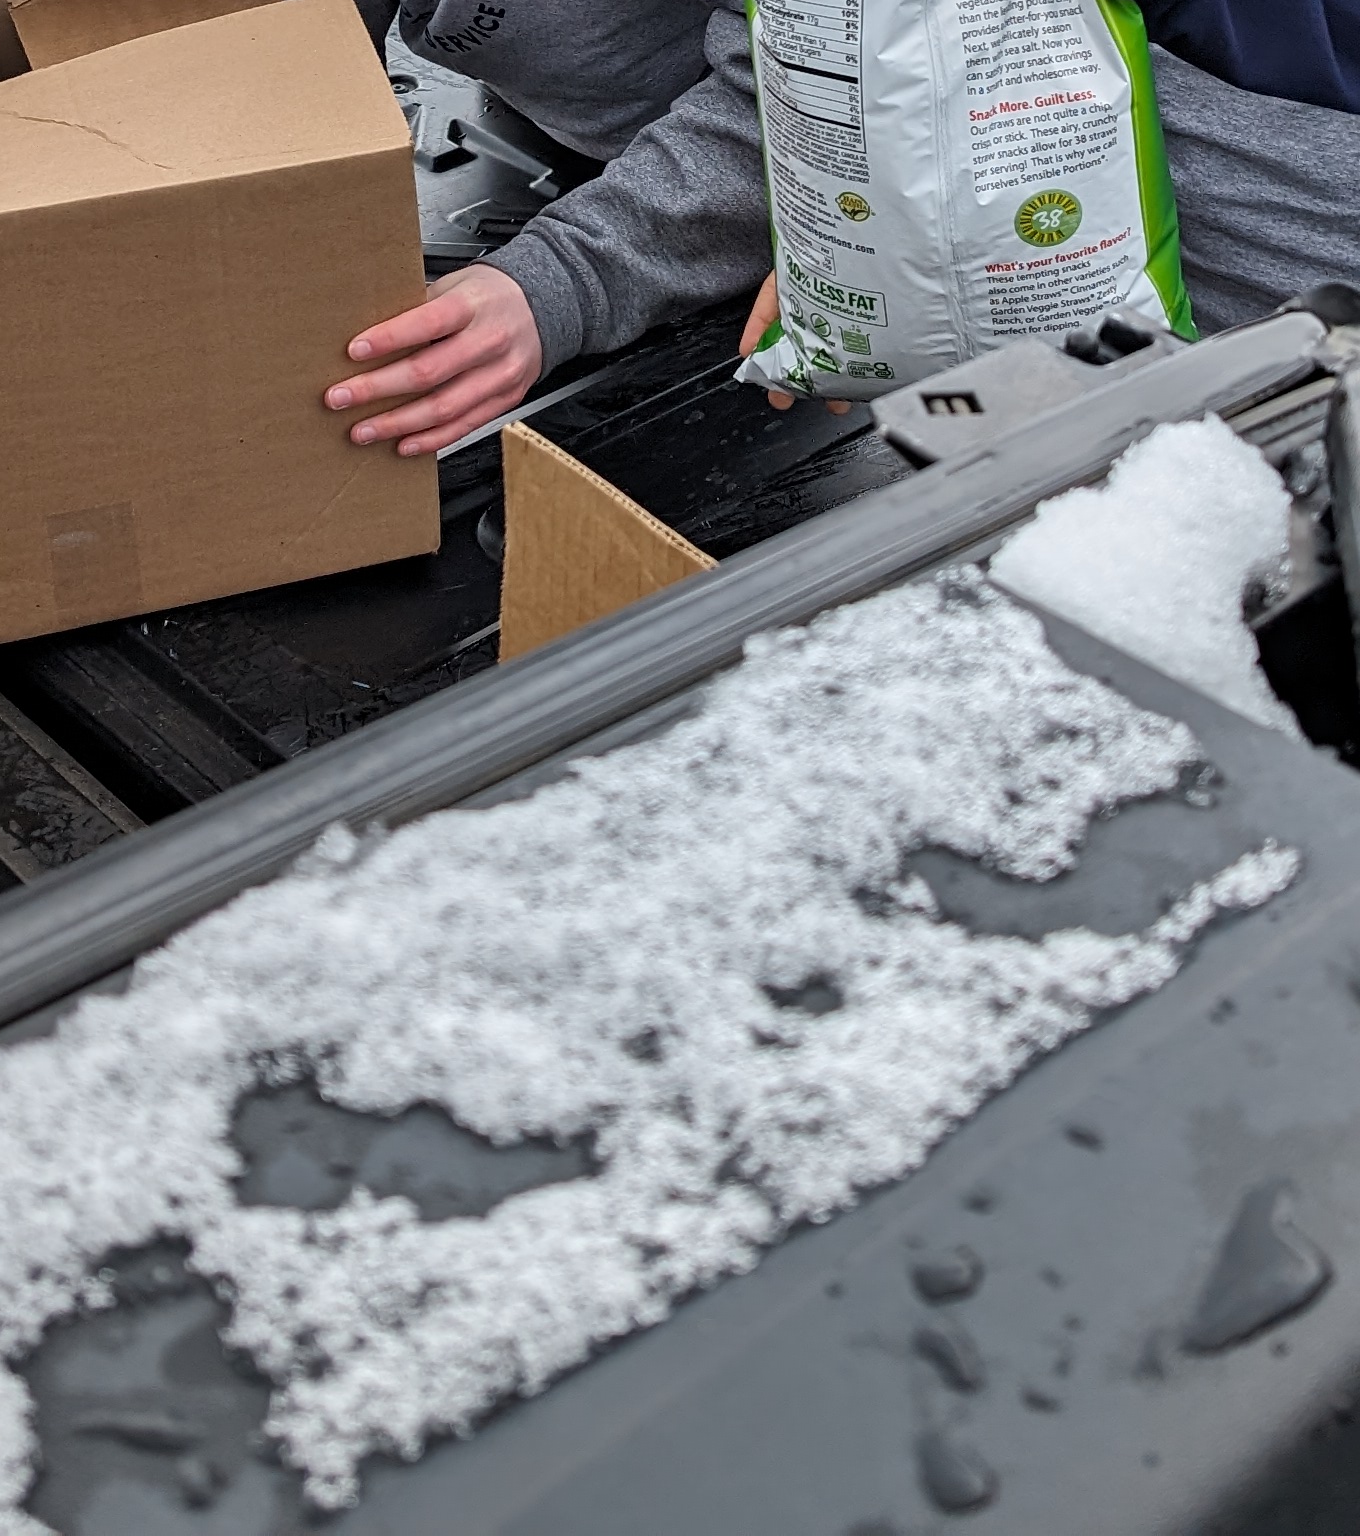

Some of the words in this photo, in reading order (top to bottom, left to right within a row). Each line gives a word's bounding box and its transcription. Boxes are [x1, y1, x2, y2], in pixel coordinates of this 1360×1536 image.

[958, 11, 982, 25] than
[983, 9, 999, 20] the
[961, 23, 1001, 42] provides
[963, 41, 990, 54] Next,
[1041, 22, 1072, 35] season
[965, 56, 991, 68] them
[1004, 46, 1020, 57] sea
[1021, 40, 1041, 53] salt.
[1042, 38, 1063, 50] Now
[1063, 35, 1083, 49] you
[966, 71, 983, 81] can
[1004, 59, 1025, 73] your
[1026, 53, 1054, 68] snack
[1054, 48, 1093, 64] cravings
[967, 85, 976, 96] in
[978, 86, 985, 95] a
[1005, 74, 1023, 86] and
[1023, 64, 1079, 83] wholesome
[1079, 63, 1102, 77] way.
[968, 104, 998, 122] Snack
[999, 101, 1033, 114] More.
[1034, 93, 1065, 108] Guilt
[1066, 90, 1097, 103] Less.
[970, 124, 988, 136] Our
[1016, 114, 1032, 125] are
[1034, 112, 1052, 124] not
[1053, 107, 1079, 121] quite
[1080, 106, 1087, 115] a
[1089, 102, 1113, 114] chip,
[992, 135, 1003, 145] or
[1004, 130, 1028, 143] stick.
[1030, 125, 1060, 139] These
[1060, 122, 1081, 135] airy,
[1082, 112, 1120, 130] crunchy
[972, 152, 996, 166] straw
[997, 144, 1029, 161] snacks
[1030, 139, 1057, 154] allow
[1058, 136, 1073, 148] for
[1074, 134, 1087, 146] 38
[1088, 126, 1118, 142] straws
[973, 168, 988, 182] per
[989, 159, 1028, 175] serving!
[1030, 155, 1054, 167] That
[1055, 152, 1064, 163] is
[1064, 148, 1086, 163] why
[1086, 144, 1102, 154] we
[1102, 136, 1118, 151] call
[974, 177, 1020, 194] ourselves
[1020, 167, 1061, 184] Sensible
[1032, 208, 1064, 230] 38
[984, 261, 1025, 274] What's
[1023, 257, 1054, 271] your
[1054, 246, 1099, 263] favorite
[1099, 226, 1132, 251] flavor?
[986, 275, 1015, 285] These
[1016, 268, 1060, 283] tempting
[1061, 259, 1092, 273] snacks
[988, 286, 1008, 295] also
[1008, 285, 1036, 293] come
[1036, 281, 1047, 290] in
[1048, 276, 1073, 289] other
[1074, 264, 1111, 282] varieties
[1111, 254, 1130, 270] such
[813, 276, 846, 304] LESS
[848, 292, 878, 312] FAT
[989, 298, 1000, 306] as
[1001, 294, 1030, 307] Apple
[990, 305, 1026, 316] Garden
[1026, 301, 1059, 314] Veggie
[992, 316, 1024, 326] Ranch,
[1025, 316, 1036, 324] or
[1037, 310, 1072, 323] Garden
[993, 327, 1028, 337] perfect
[1028, 323, 1042, 334] for
[1043, 321, 1083, 333] dipping.
